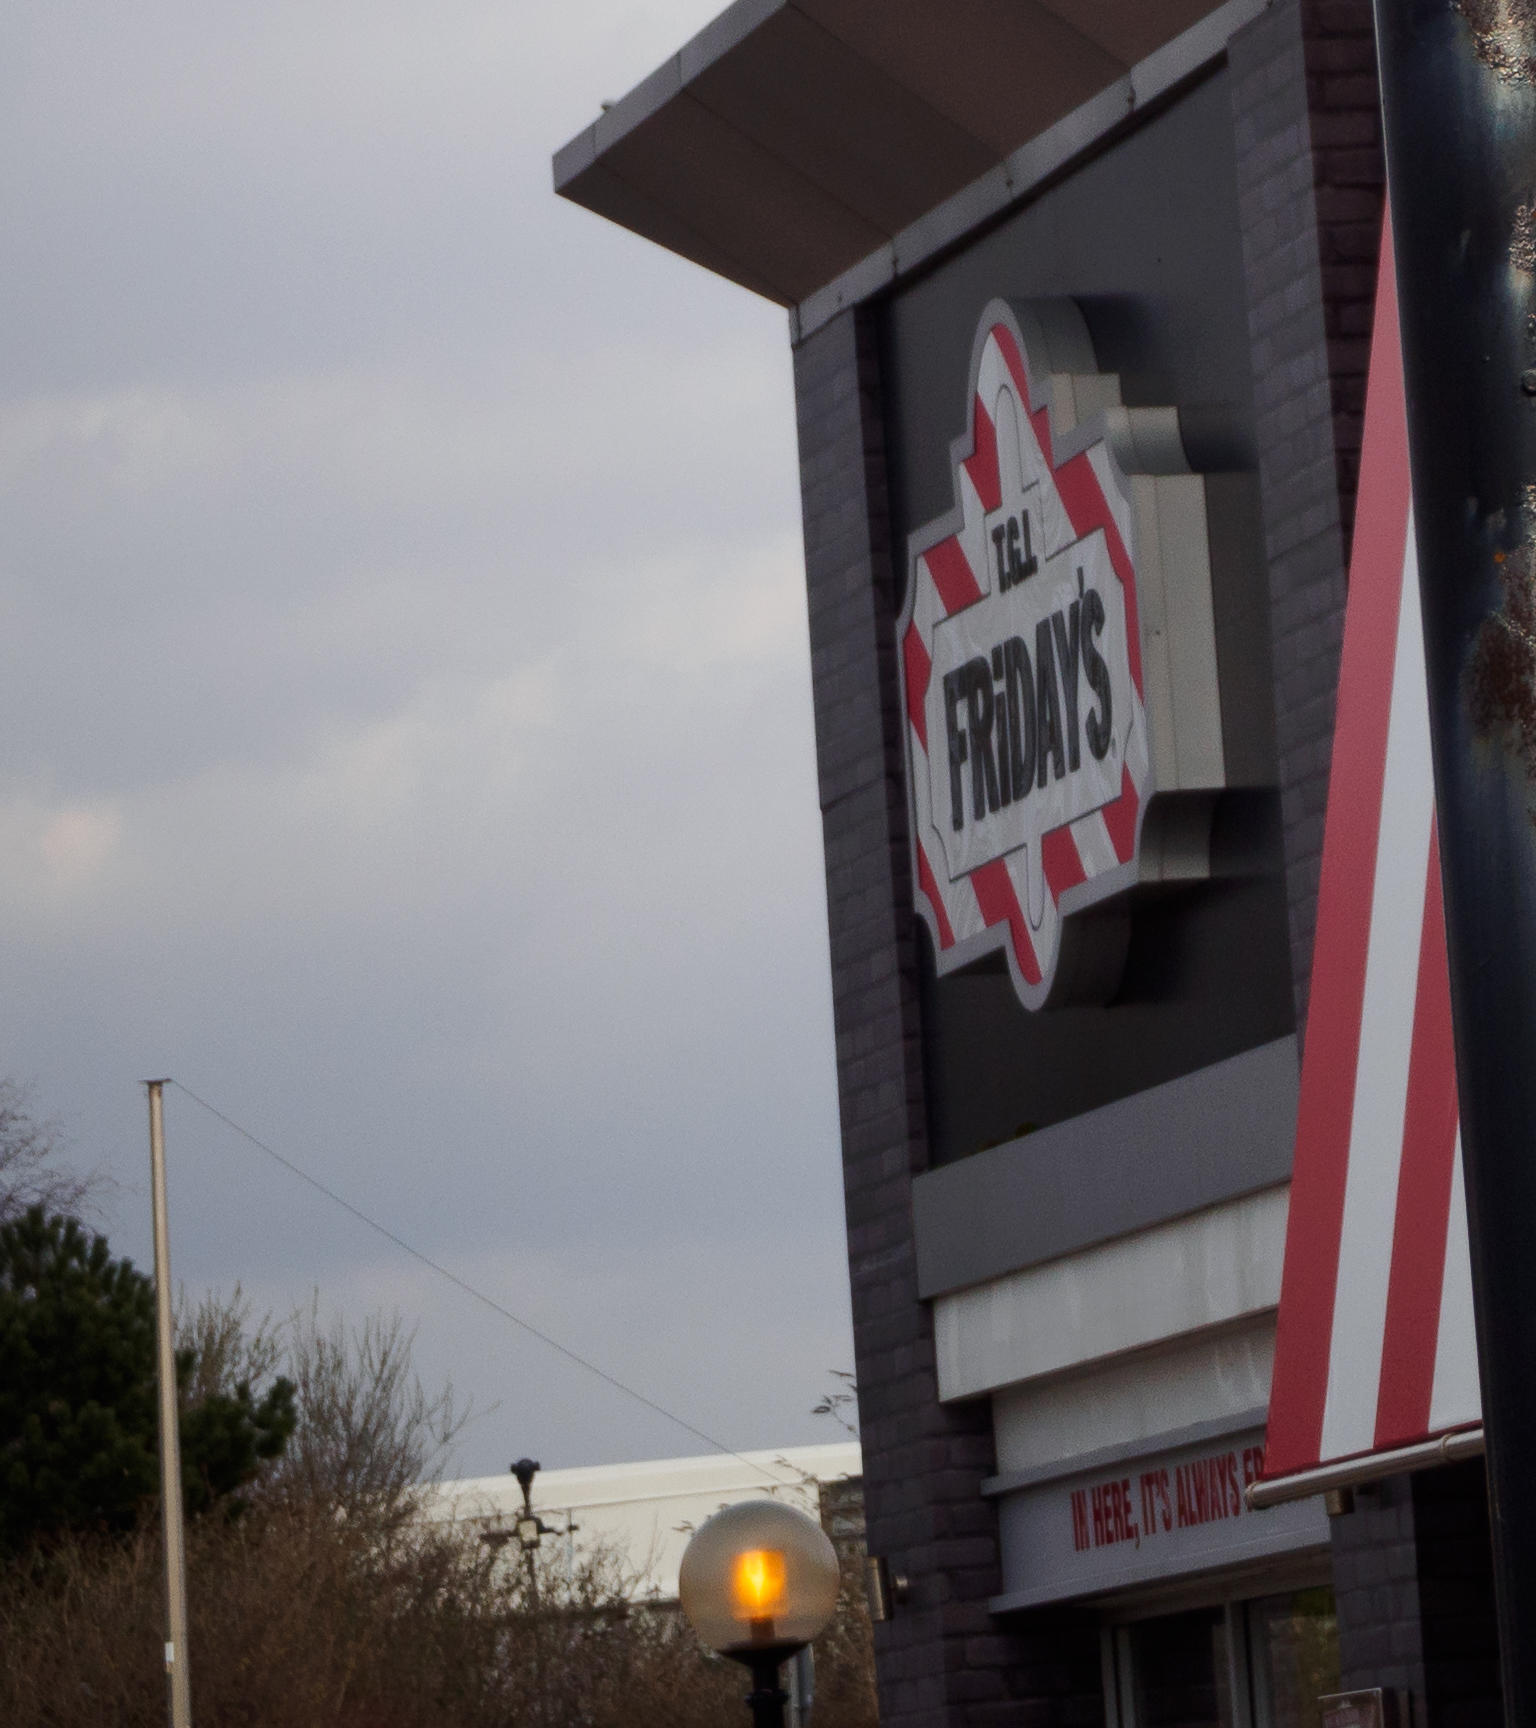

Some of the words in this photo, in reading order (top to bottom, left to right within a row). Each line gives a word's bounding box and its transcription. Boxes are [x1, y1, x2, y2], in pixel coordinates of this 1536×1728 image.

[991, 508, 1038, 594] T.G.I.
[1070, 1489, 1091, 1552] IN
[1091, 1478, 1140, 1550] HERE,
[1140, 1468, 1172, 1536] IT'S
[1175, 1451, 1241, 1529] ALWAYS
